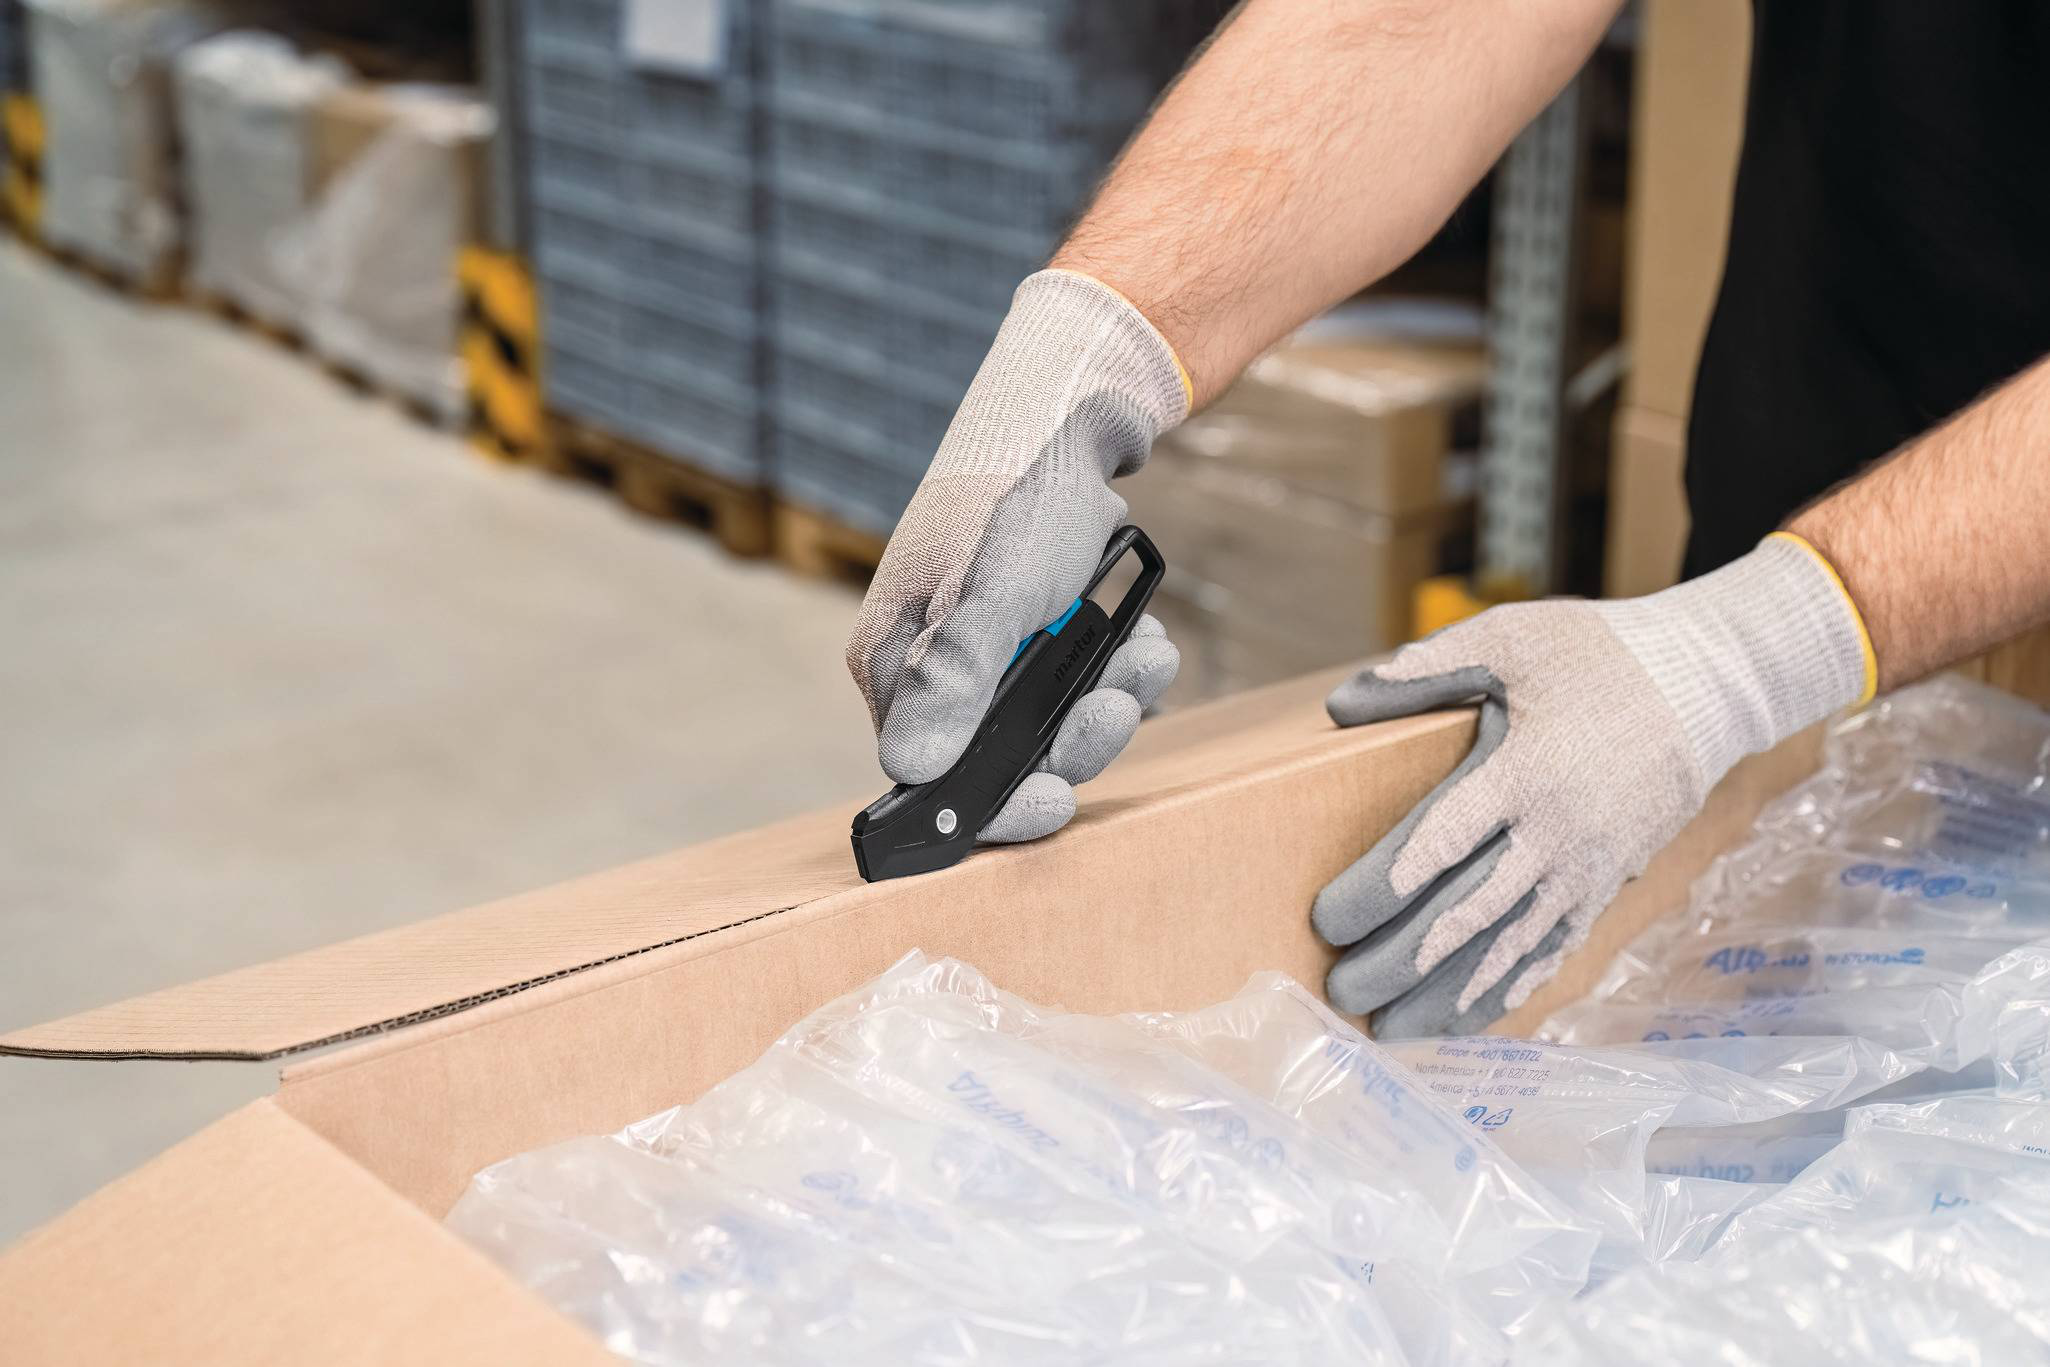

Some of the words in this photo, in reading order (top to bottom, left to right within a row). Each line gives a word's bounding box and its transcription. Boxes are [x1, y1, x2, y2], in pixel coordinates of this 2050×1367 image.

[1054, 623, 1096, 683] martor
[1437, 1047, 1469, 1058] Europe
[1416, 1063, 1438, 1074] North
[1440, 1064, 1475, 1077] America
